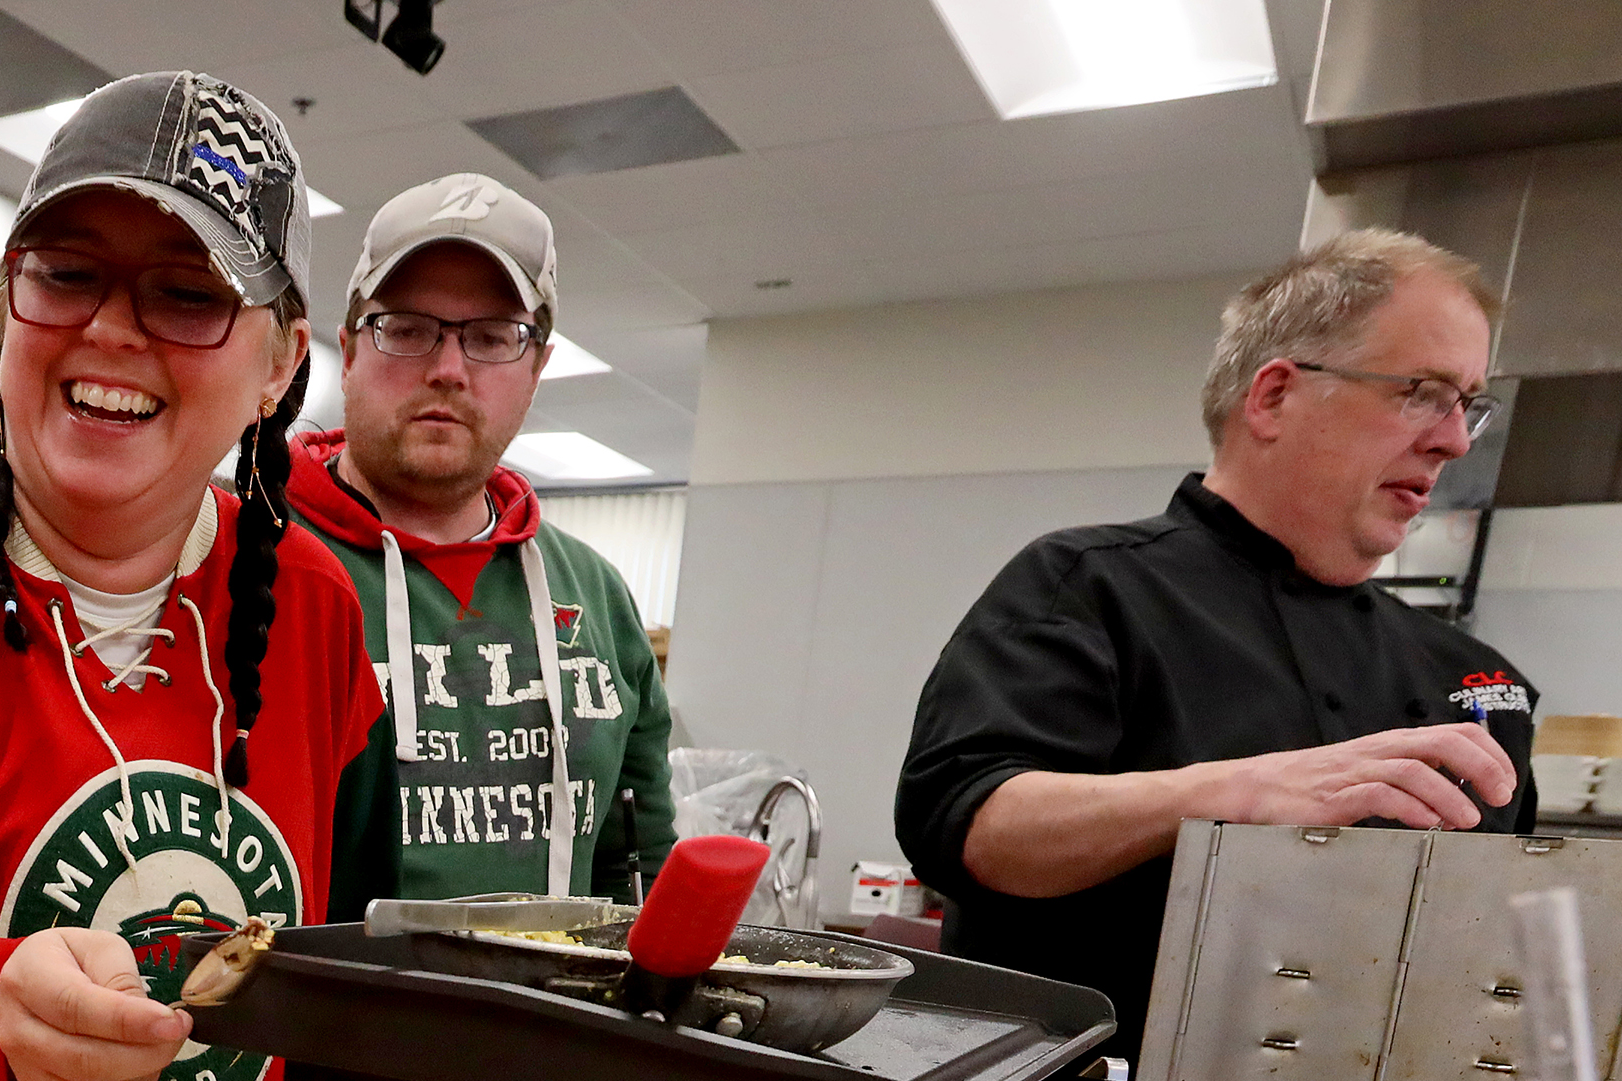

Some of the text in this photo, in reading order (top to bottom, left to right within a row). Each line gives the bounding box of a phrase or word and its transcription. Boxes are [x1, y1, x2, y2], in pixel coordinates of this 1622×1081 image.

[372, 643, 624, 720] ILD
[414, 730, 468, 762] EST.
[400, 779, 596, 845] INNESOTA
